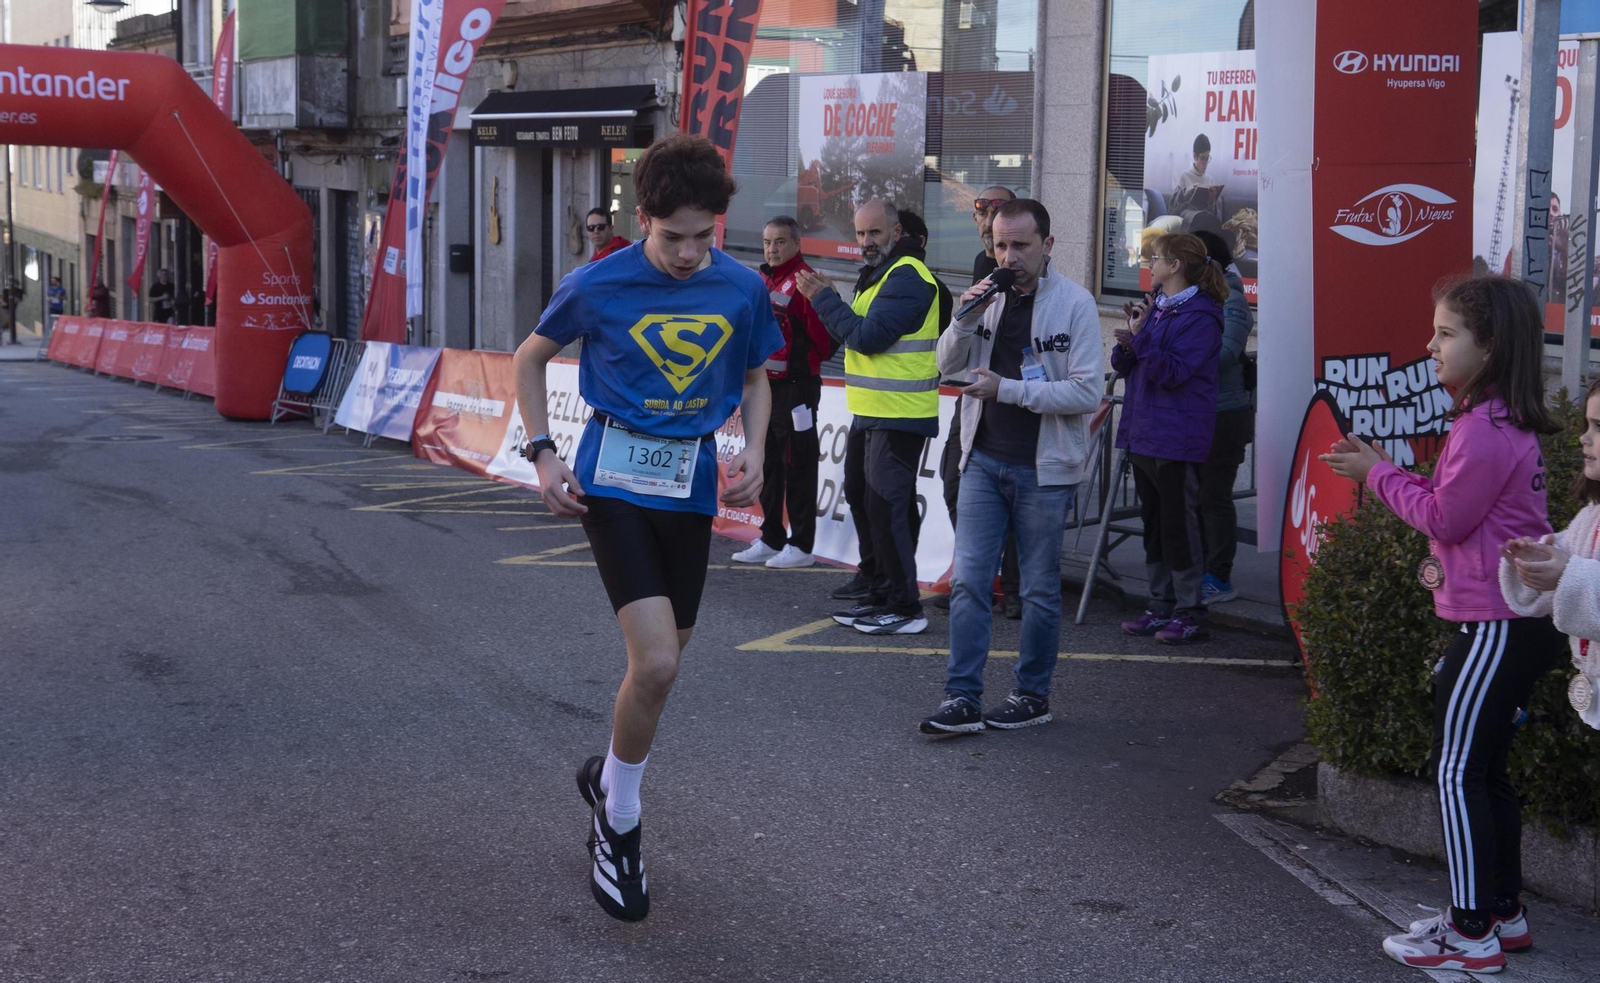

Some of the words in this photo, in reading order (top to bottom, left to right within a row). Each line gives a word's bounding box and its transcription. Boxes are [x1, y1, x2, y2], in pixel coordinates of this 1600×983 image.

[1373, 54, 1460, 72] HYUNDAI
[0, 66, 130, 101] ntander
[216, 53, 229, 113] nder
[1207, 71, 1218, 85] TU
[1387, 78, 1426, 89] Hyupersa
[1427, 78, 1446, 89] Vigo
[1205, 89, 1257, 122] PLAN
[824, 103, 843, 137] DE
[844, 102, 898, 137] COCHE
[600, 125, 627, 136] KELER
[1335, 208, 1375, 224] Frutas
[1415, 206, 1455, 223] Nieves
[262, 272, 301, 287] Sports
[1243, 283, 1259, 295] NFÓ
[257, 292, 311, 306] Santander
[1324, 356, 1389, 388] RUN
[547, 389, 595, 425] CELLO
[672, 400, 683, 410] AO
[1352, 406, 1416, 438] RUN
[628, 445, 674, 468] 1302
[726, 508, 750, 525] CIDADE
